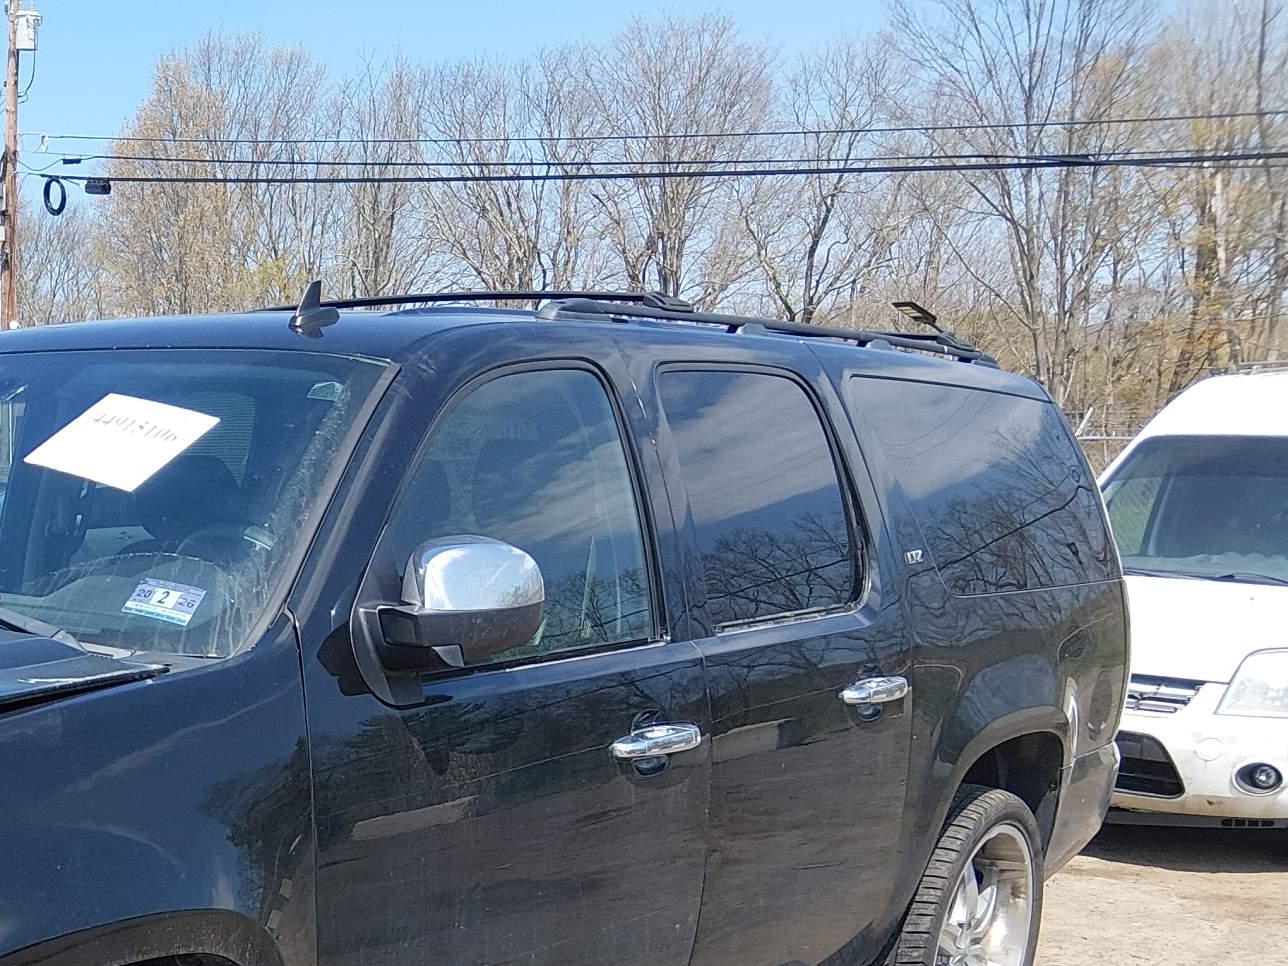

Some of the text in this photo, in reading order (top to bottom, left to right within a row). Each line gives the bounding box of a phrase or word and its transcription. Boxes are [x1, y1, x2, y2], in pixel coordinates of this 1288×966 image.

[136, 588, 197, 608] 20 2 26
